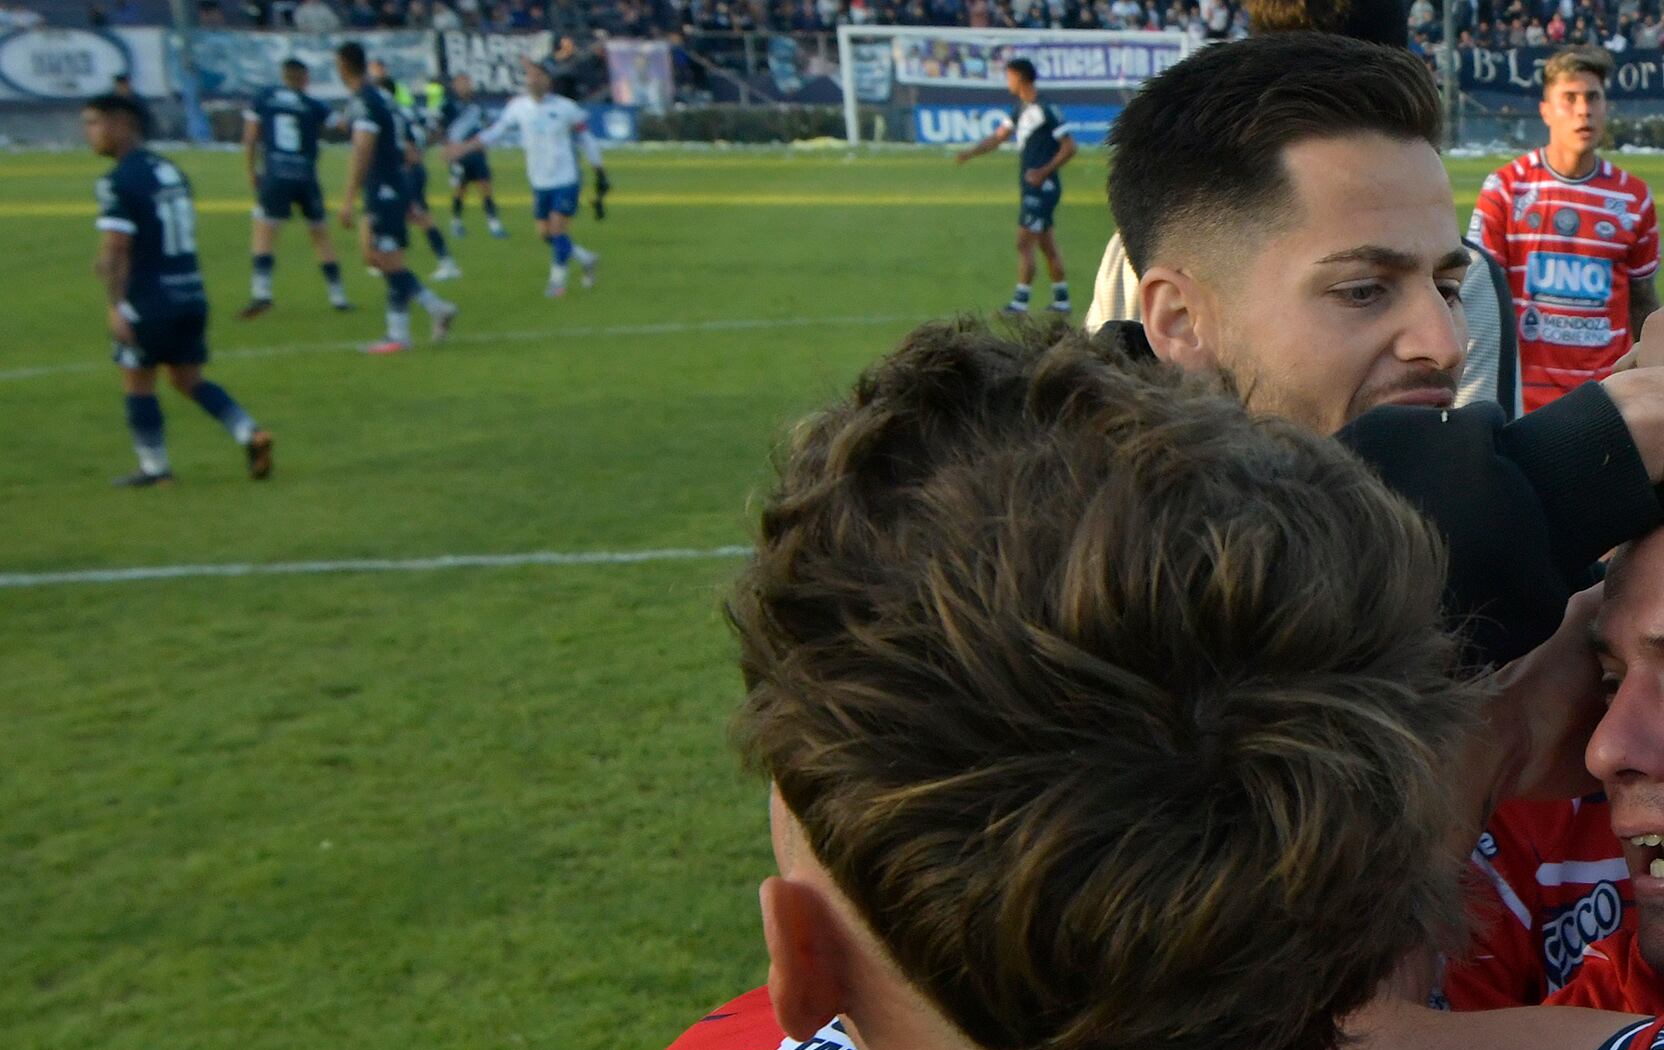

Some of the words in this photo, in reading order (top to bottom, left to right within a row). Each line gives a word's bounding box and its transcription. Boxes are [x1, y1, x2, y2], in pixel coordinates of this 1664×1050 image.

[920, 108, 1013, 143] UNO
[1534, 257, 1607, 293] UNO
[1543, 314, 1610, 331] MENDOZA
